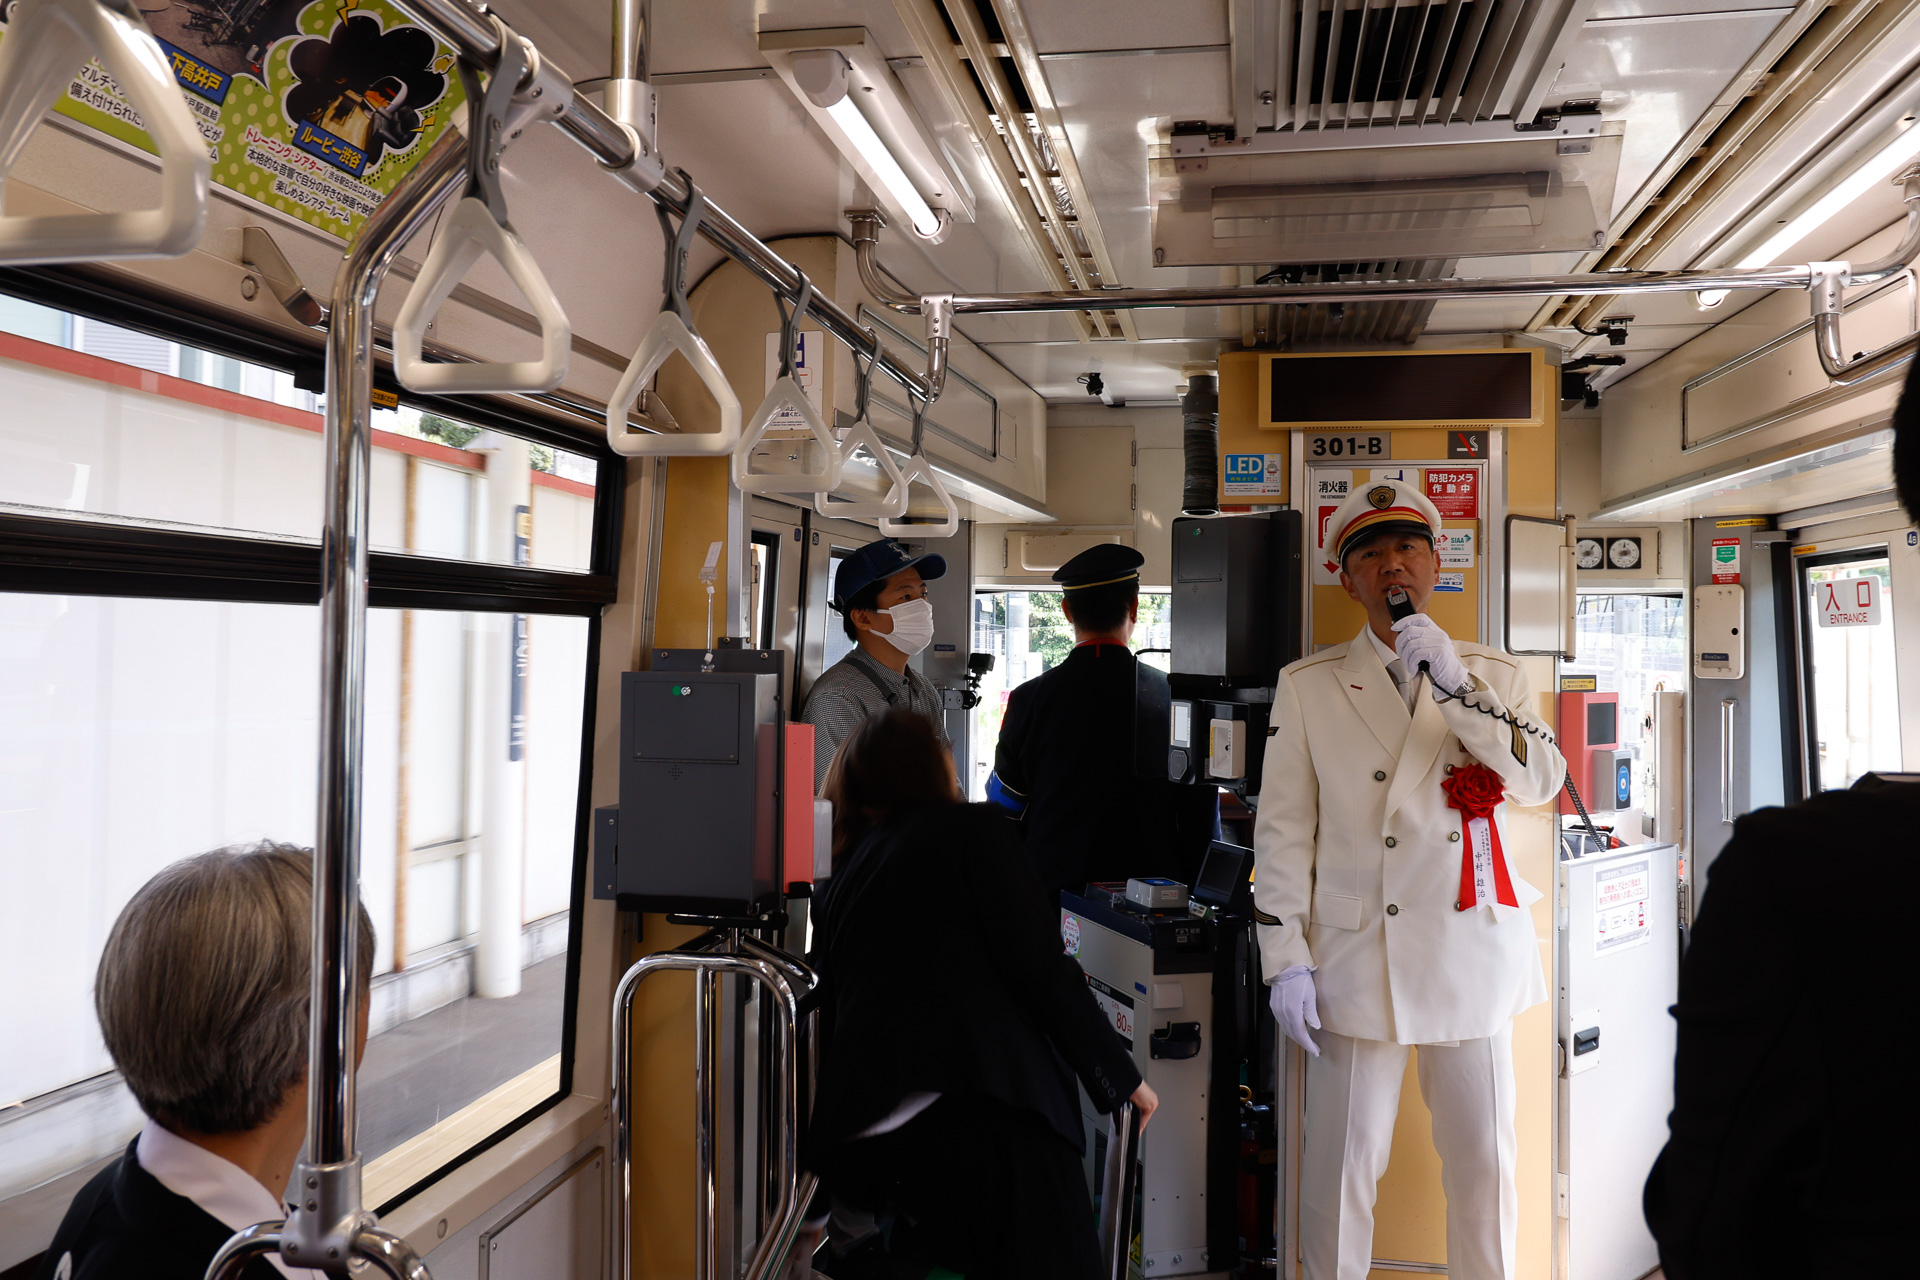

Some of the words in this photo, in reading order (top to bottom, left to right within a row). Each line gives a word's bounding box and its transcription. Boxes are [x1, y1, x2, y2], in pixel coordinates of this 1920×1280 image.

[80, 66, 126, 98] マルチマ
[167, 51, 223, 90] 下高井戸
[70, 81, 145, 127] 備え付けられた
[245, 127, 323, 172] トレーニング・シアター
[301, 126, 361, 170] ルービー渋谷
[275, 180, 350, 223] 楽しめるシアタールーム
[1312, 437, 1382, 457] 301-B
[1226, 456, 1263, 475] LED
[1429, 473, 1473, 483] 防犯カメラ
[1318, 480, 1348, 493] 消火器
[1432, 483, 1470, 493] 作動中
[1825, 581, 1871, 611] 入口
[1830, 612, 1868, 624] ENTRANCE
[1475, 851, 1483, 872] 中村
